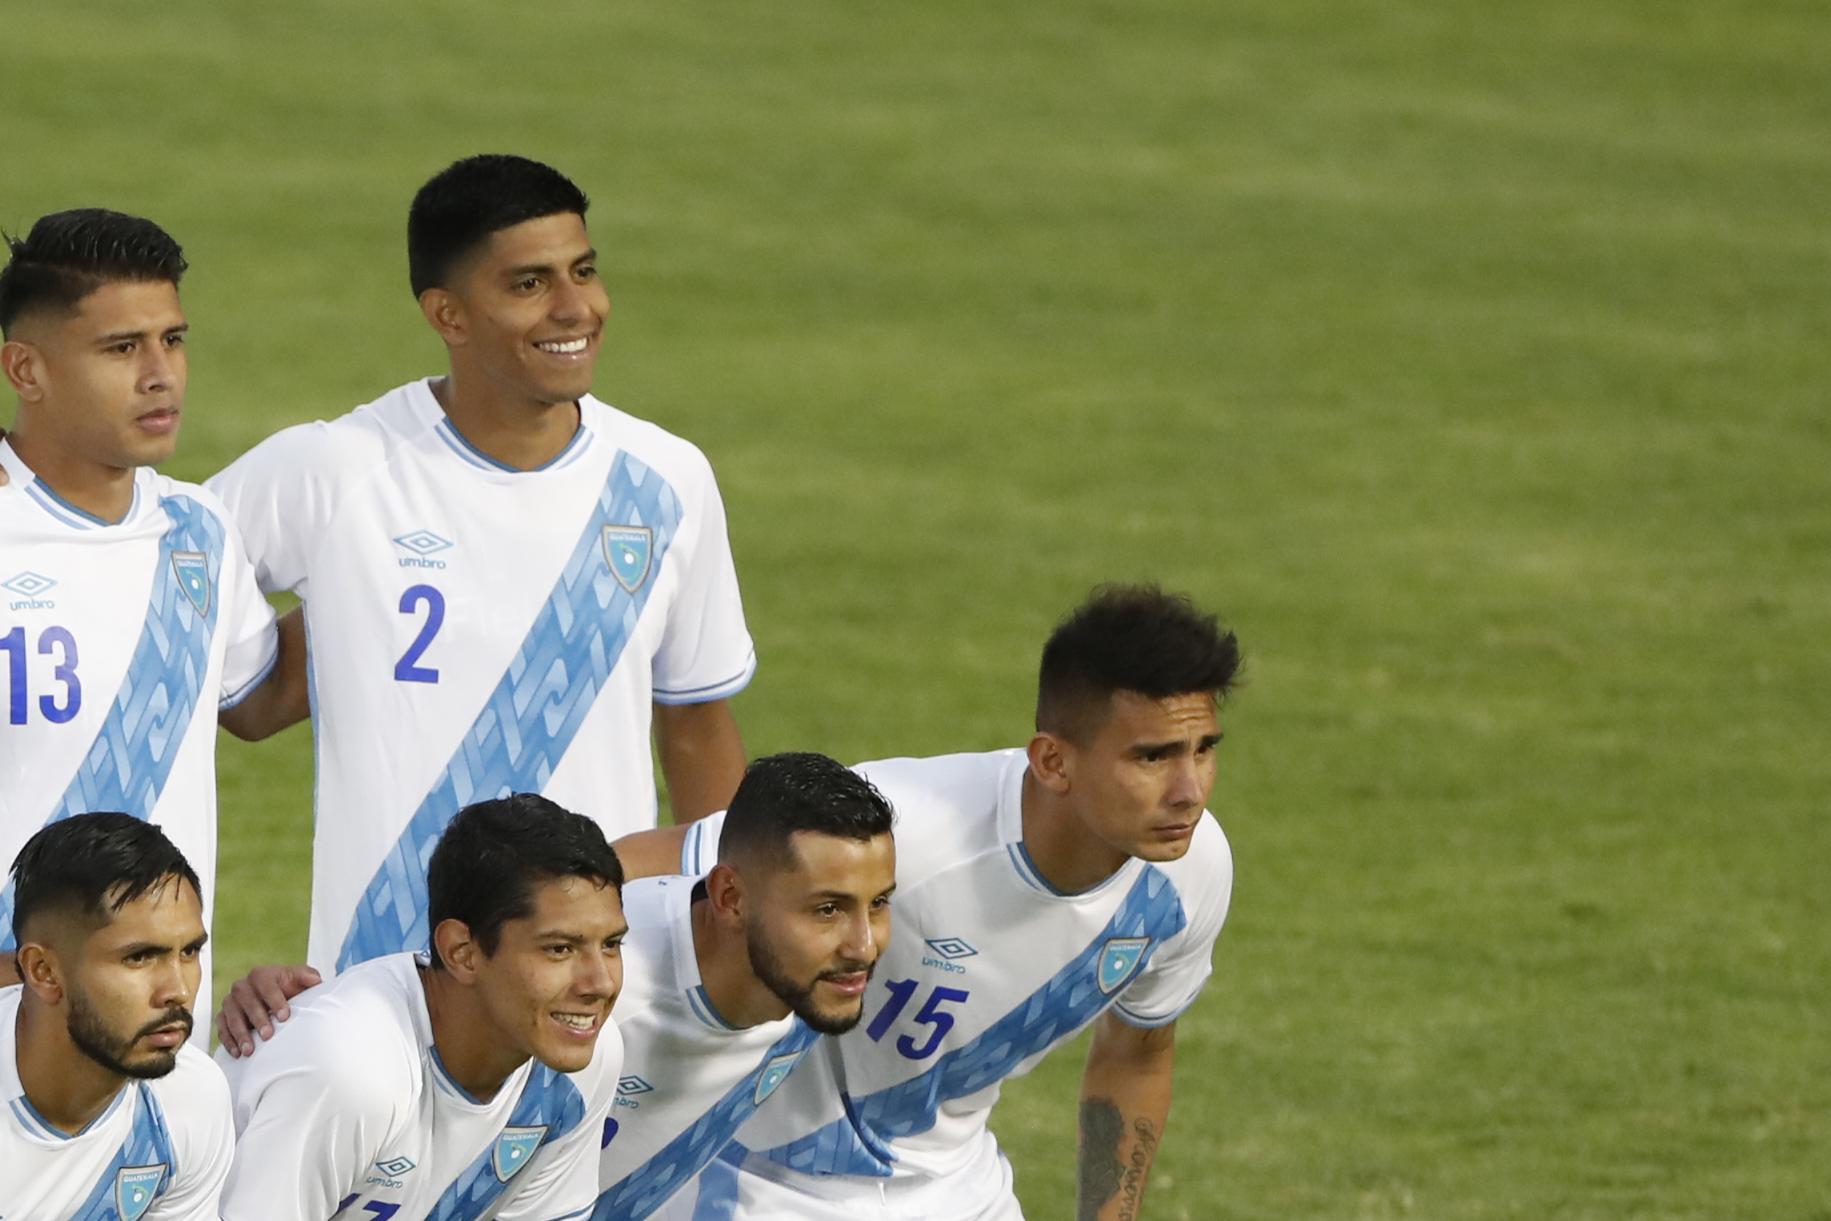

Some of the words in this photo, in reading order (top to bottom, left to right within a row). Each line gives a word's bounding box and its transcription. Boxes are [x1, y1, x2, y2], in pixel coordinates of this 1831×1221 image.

[398, 557, 447, 570] umbro
[10, 598, 55, 611] umbro
[394, 584, 445, 684] 2
[866, 978, 967, 1061] 15
[122, 1172, 159, 1183] GUATEMALA
